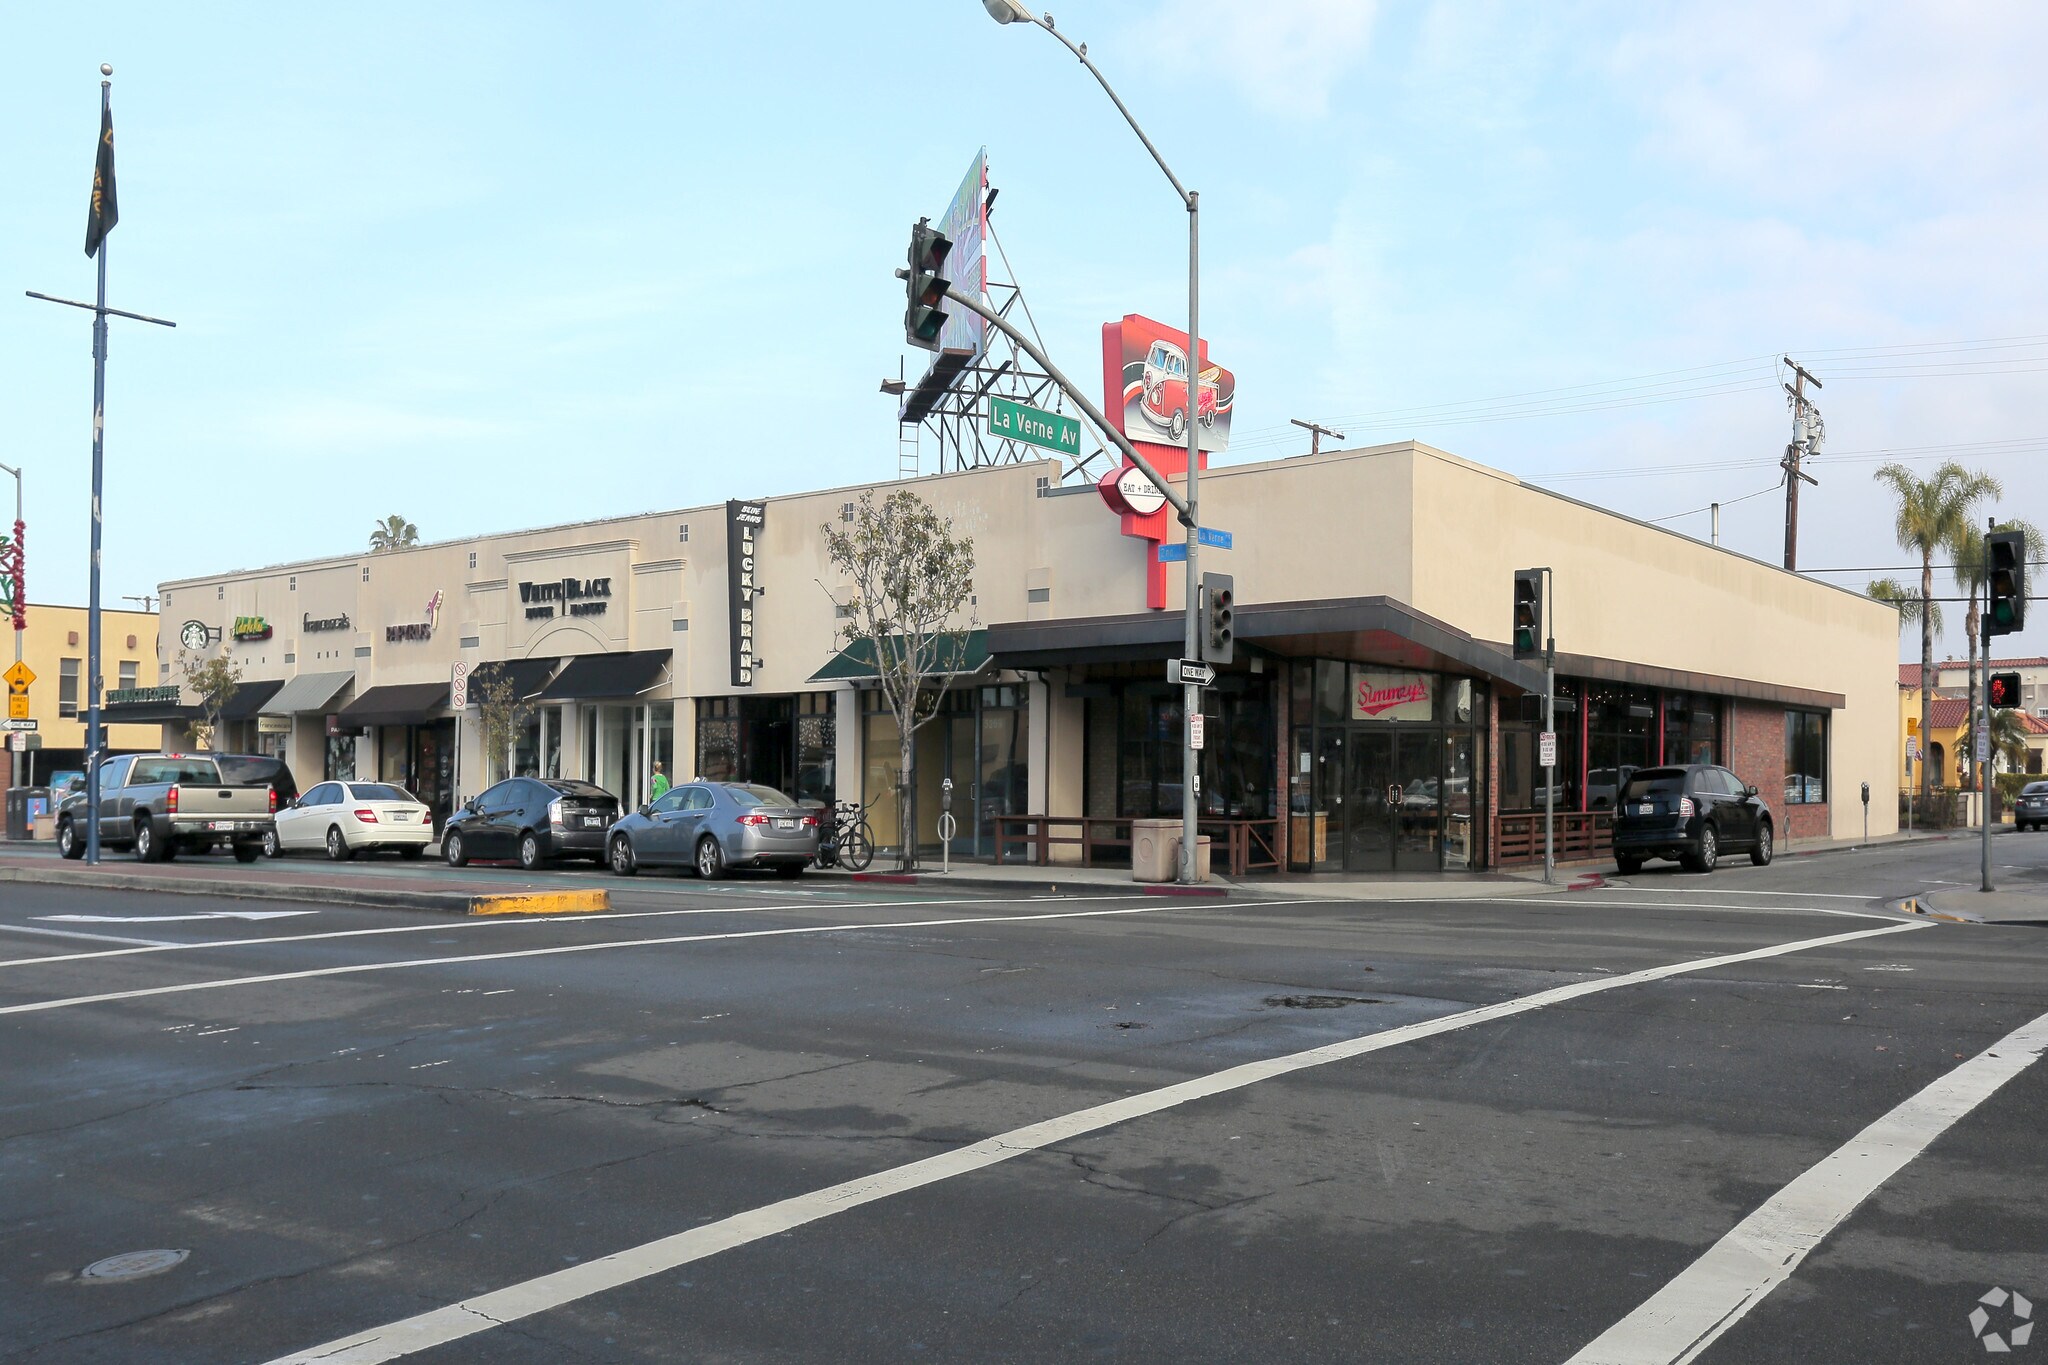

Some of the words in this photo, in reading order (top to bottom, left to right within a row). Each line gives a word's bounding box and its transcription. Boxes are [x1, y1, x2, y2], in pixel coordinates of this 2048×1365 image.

[993, 406, 1010, 429] La
[1016, 412, 1054, 440] Verne
[1060, 425, 1077, 446] Av
[1123, 483, 1135, 493] EAT
[1143, 484, 1162, 495] DRIN
[736, 513, 762, 524] JEANS
[741, 505, 762, 515] BLUE
[741, 526, 754, 602] LUCKY
[565, 578, 612, 598] BLACK
[303, 612, 350, 633] francesca's
[386, 623, 431, 641] PAPYRUS
[740, 608, 752, 683] BRAND
[1183, 666, 1194, 676] ONE
[1195, 669, 1206, 678] WAY
[150, 685, 180, 701] COFFEE
